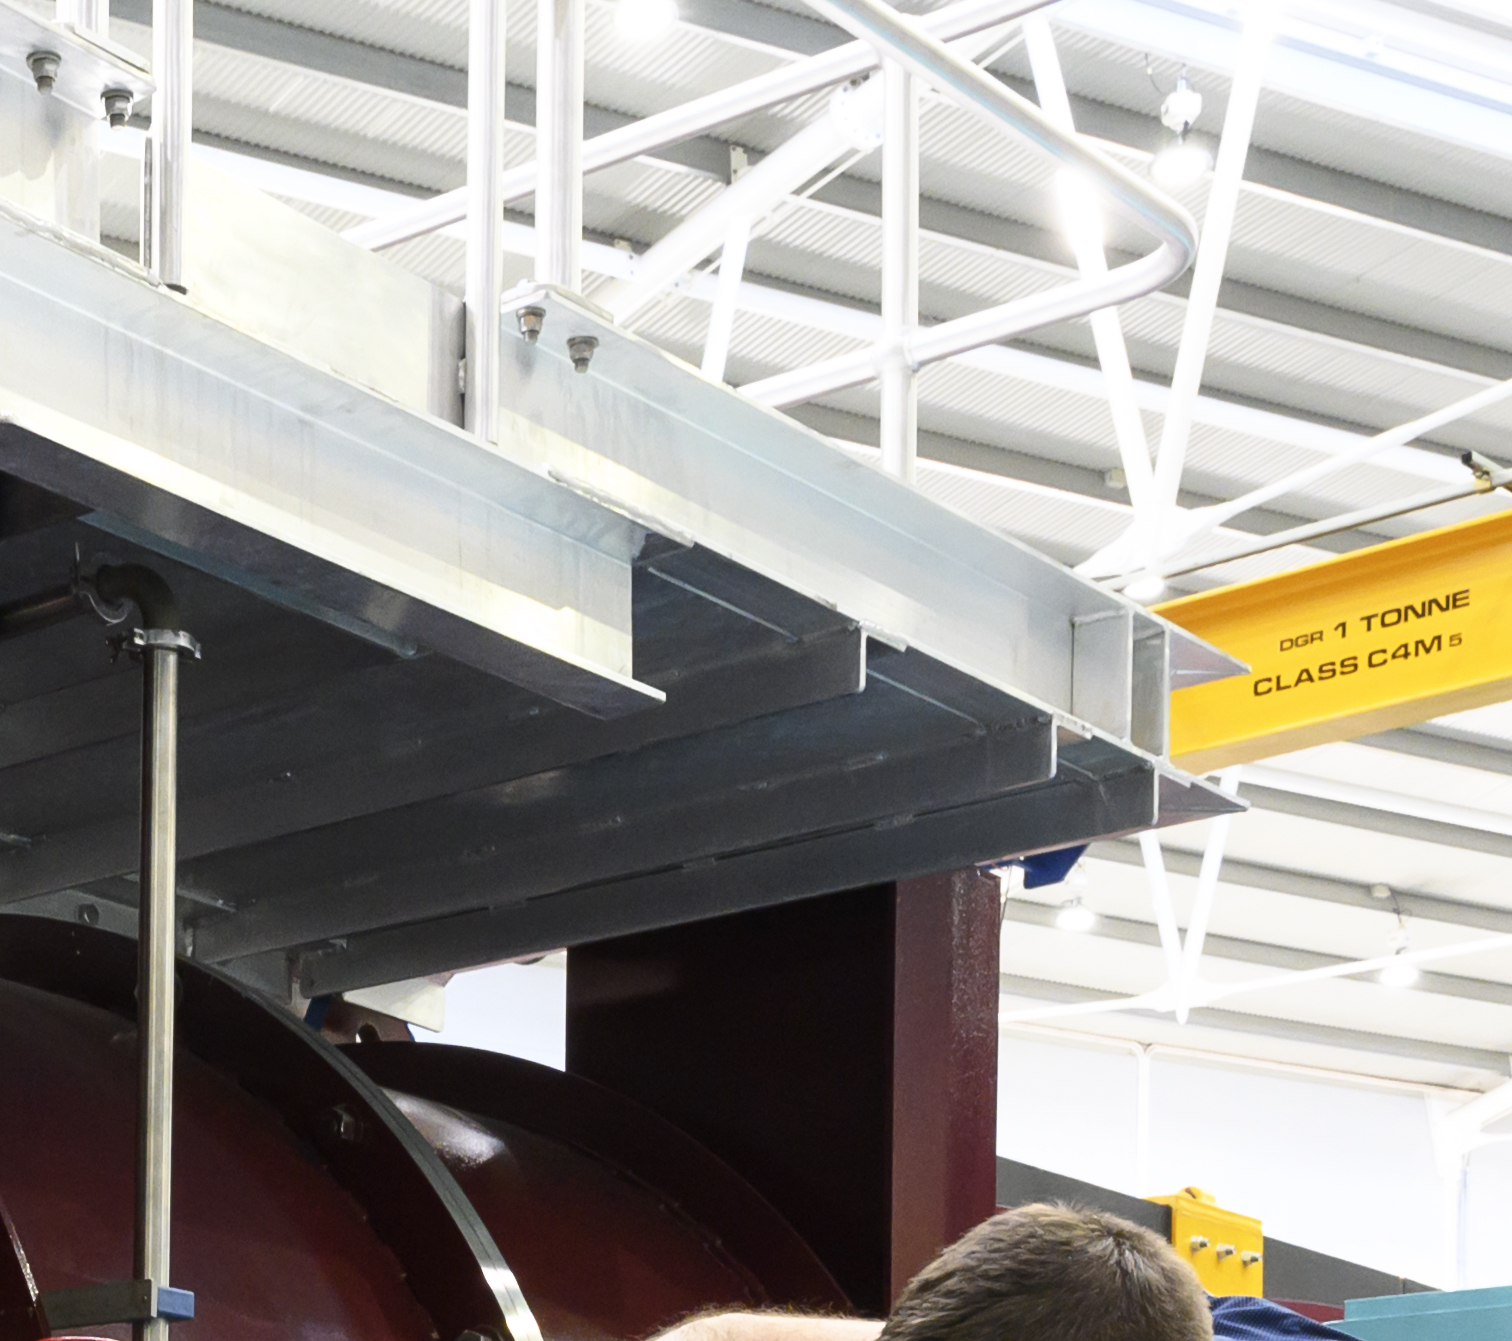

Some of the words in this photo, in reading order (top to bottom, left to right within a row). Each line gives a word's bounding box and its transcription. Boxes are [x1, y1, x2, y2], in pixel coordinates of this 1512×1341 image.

[1279, 629, 1324, 653] DGR
[1333, 621, 1348, 640] 1
[1360, 588, 1471, 634] TONNE
[1252, 655, 1359, 698] CLASS
[1367, 634, 1443, 670] C4M
